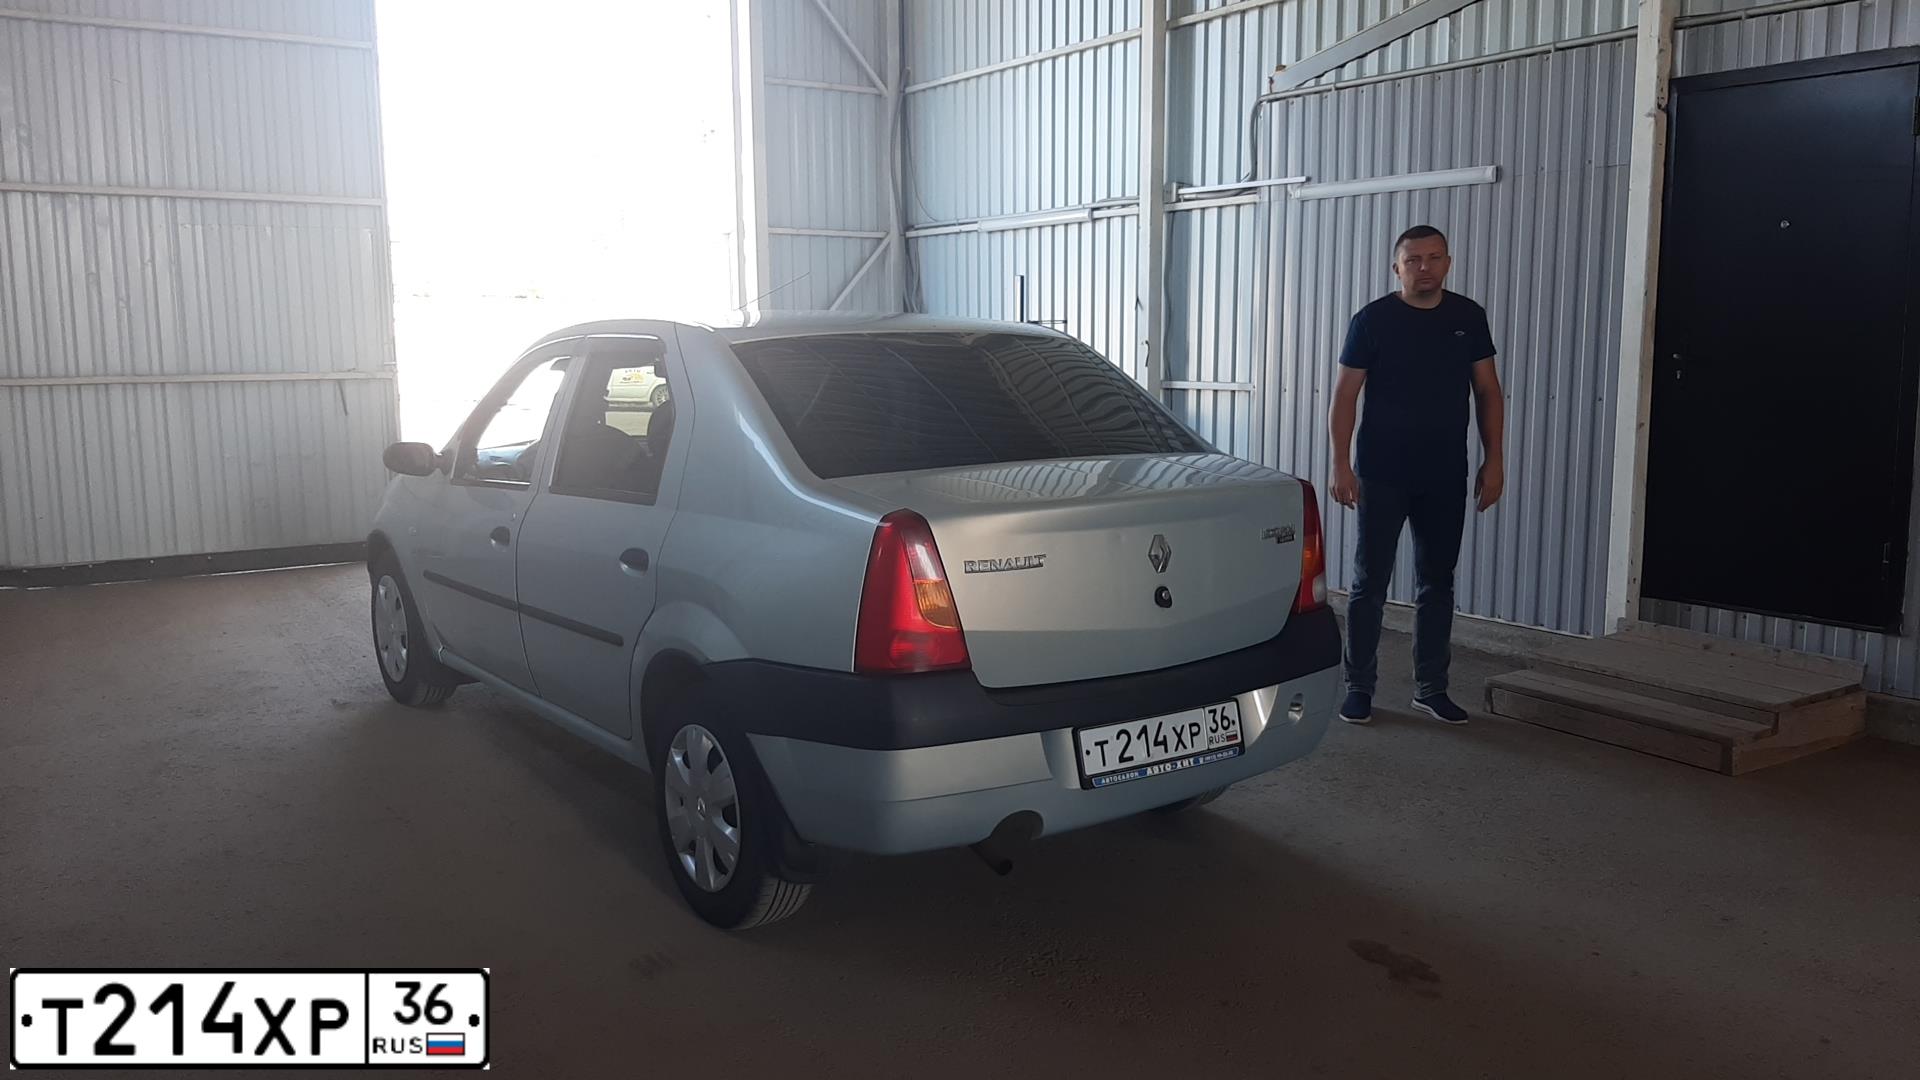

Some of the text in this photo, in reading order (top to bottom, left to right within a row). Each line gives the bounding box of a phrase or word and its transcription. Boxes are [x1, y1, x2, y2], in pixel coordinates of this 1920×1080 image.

[964, 554, 1046, 574] RENAULT
[1208, 706, 1231, 734] 36
[1209, 734, 1226, 746] RUS
